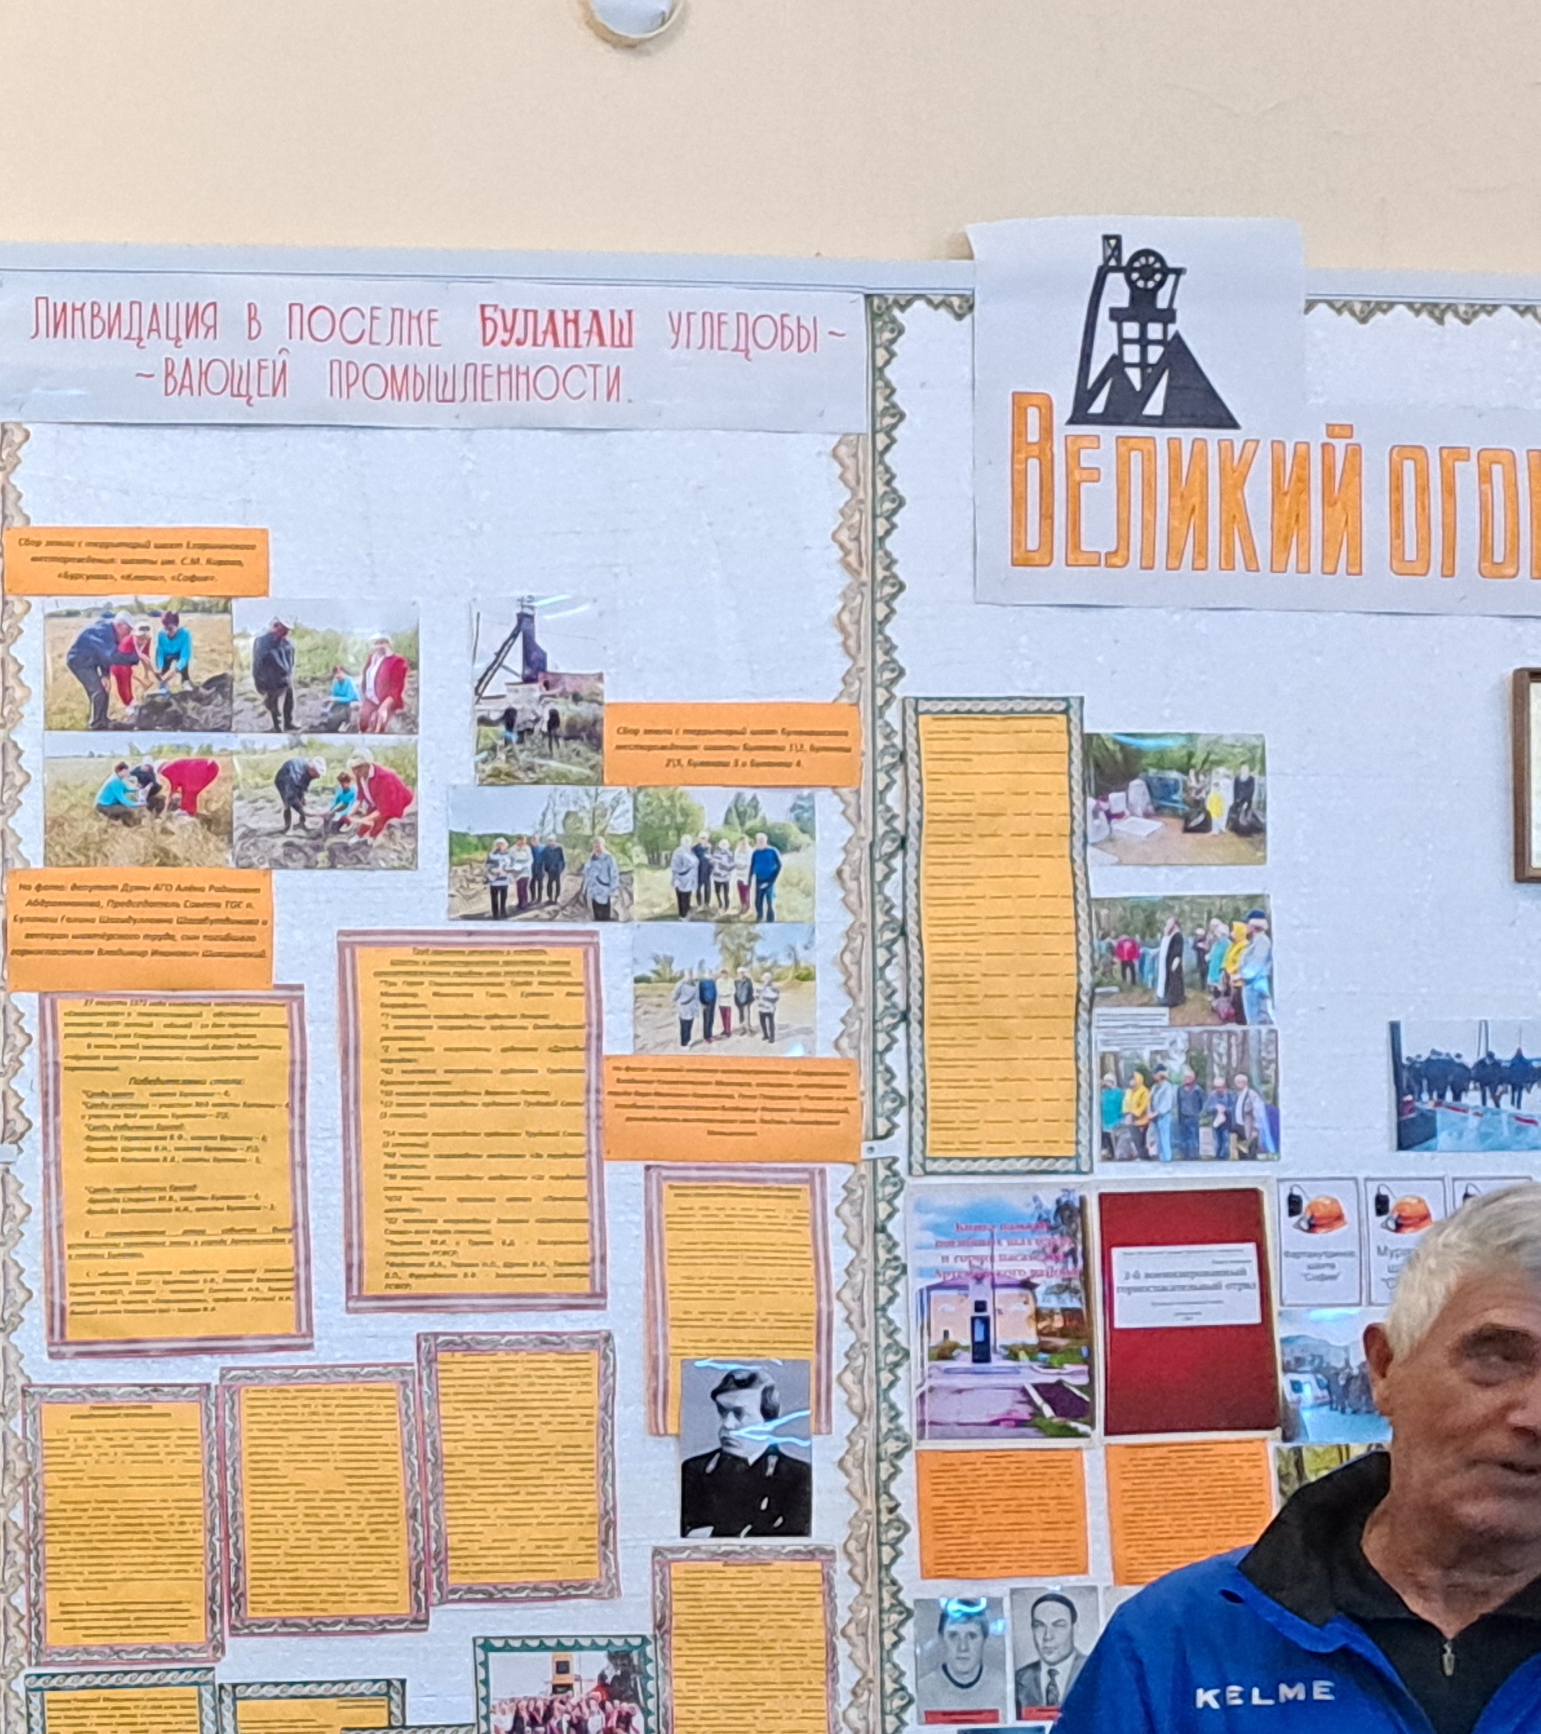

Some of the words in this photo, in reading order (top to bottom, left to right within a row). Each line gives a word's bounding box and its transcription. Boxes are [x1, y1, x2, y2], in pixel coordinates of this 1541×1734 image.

[30, 296, 218, 349] ЛИКВИДАЦИЯ
[246, 302, 263, 341] В
[287, 302, 443, 348] ПОСЕЛКЕ
[479, 303, 634, 349] БУЛАНАШ
[1010, 391, 1363, 577] ВЕЛИКИЙ
[1195, 1679, 1337, 1710] KELME
